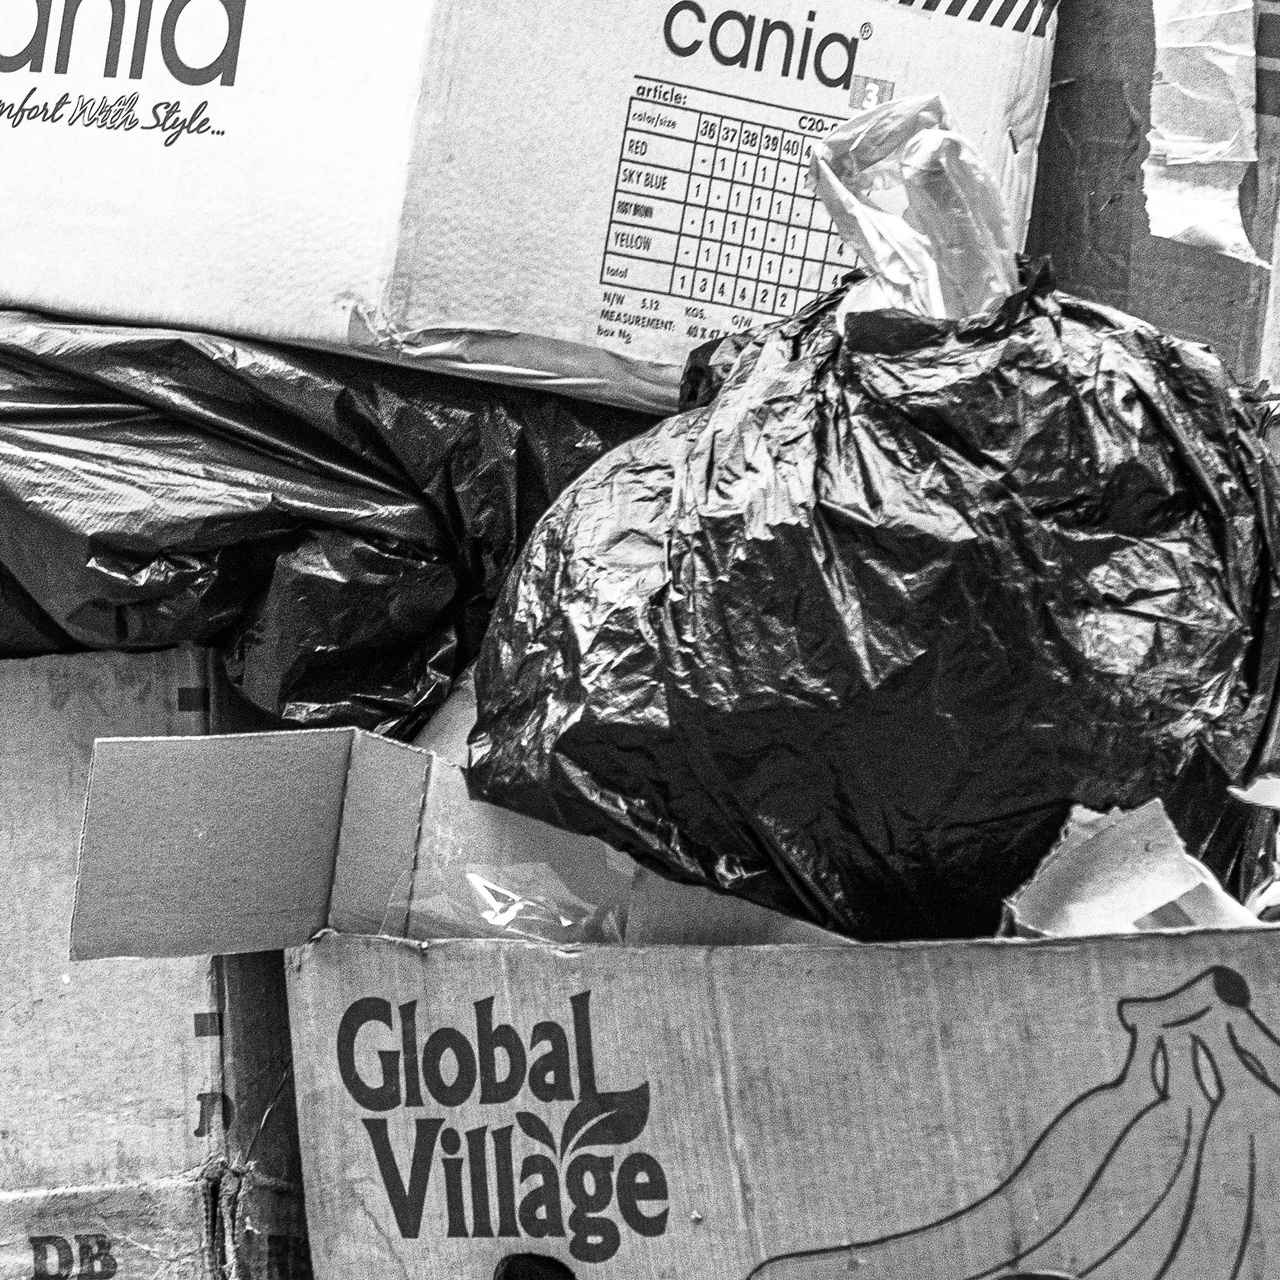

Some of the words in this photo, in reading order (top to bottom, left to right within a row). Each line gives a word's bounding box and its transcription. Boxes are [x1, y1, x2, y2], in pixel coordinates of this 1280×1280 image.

[68, 91, 140, 131] With
[635, 84, 688, 106] article:
[628, 138, 648, 157] RED
[631, 110, 677, 130] color/size
[699, 120, 717, 140] 36
[721, 126, 738, 144] 37
[741, 129, 758, 148] 38
[762, 134, 779, 152] 39
[783, 139, 799, 156] 40
[621, 167, 643, 186] SKY
[643, 172, 669, 191] BLUE
[614, 230, 653, 252] YELLOW
[605, 266, 629, 280] total
[760, 288, 769, 304] 2
[780, 292, 788, 308] 2
[600, 308, 676, 332] MEASUREMENT:
[336, 990, 650, 1112] Global
[361, 1117, 670, 1264] Village
